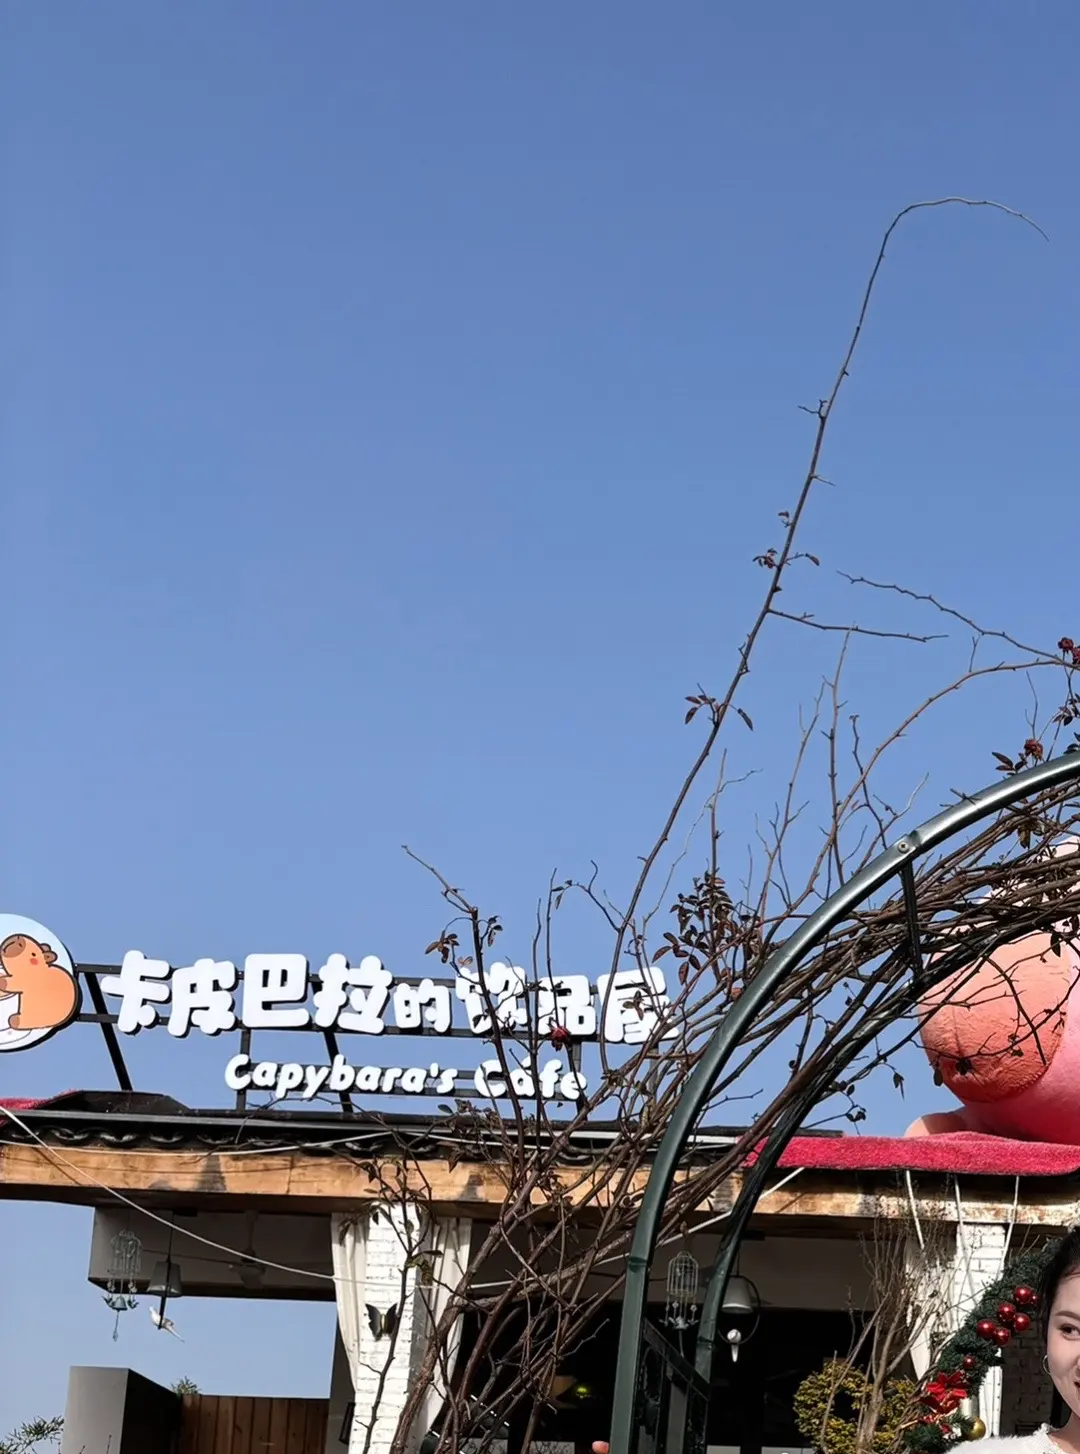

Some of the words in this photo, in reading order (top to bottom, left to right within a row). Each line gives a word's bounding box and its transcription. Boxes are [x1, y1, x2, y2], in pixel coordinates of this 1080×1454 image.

[101, 950, 680, 1044] 卡皮巴拉的饮品屋
[225, 1054, 458, 1099] Capybara's
